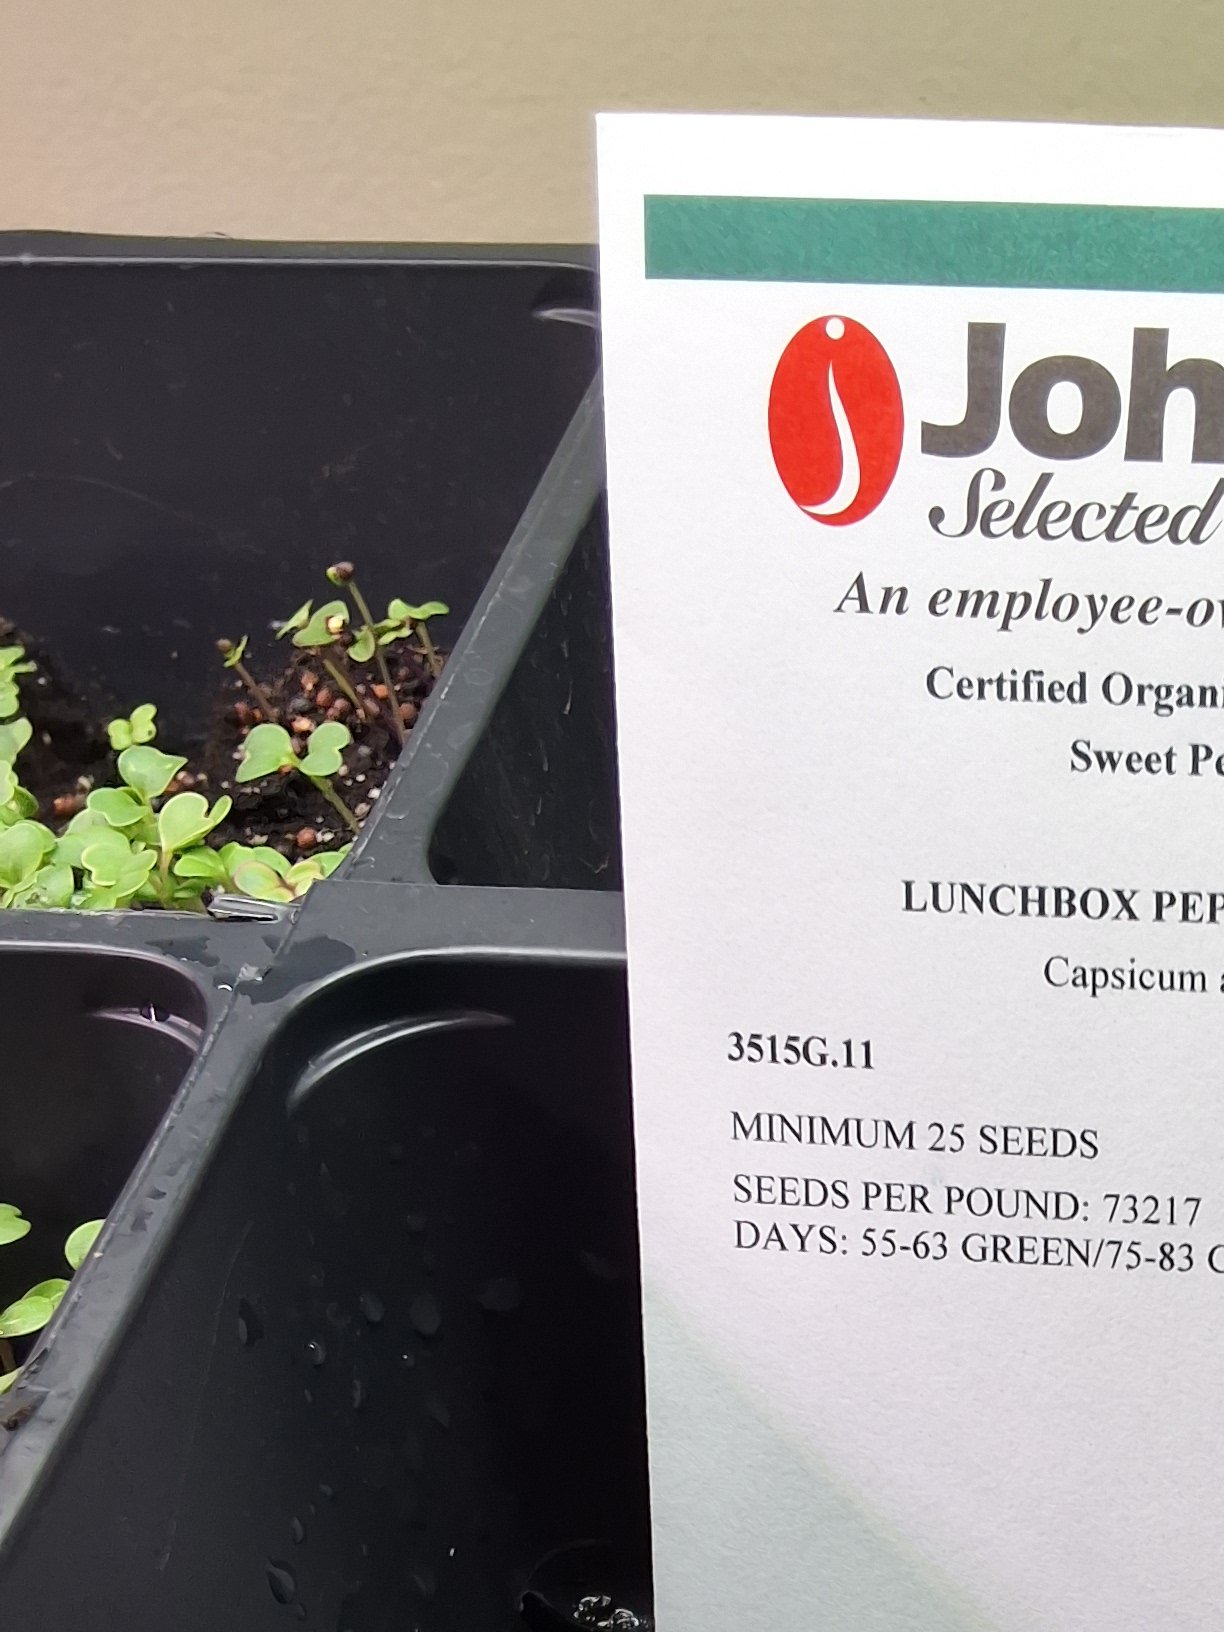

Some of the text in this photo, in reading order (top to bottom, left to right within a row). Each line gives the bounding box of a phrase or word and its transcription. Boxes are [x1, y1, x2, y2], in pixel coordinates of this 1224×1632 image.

[833, 571, 908, 615] An
[927, 666, 1087, 704] Certified
[1071, 740, 1176, 775] Sweet
[903, 881, 1139, 921] LUNCHBOX
[1044, 956, 1206, 998] Capsicum
[728, 1032, 873, 1069] 3515G.11
[732, 1112, 1098, 1159] MINIMUM 25 SEEDS
[734, 1174, 1201, 1226] SEEDS PER POUND: 73217
[735, 1220, 847, 1255] DAYS:
[862, 1228, 947, 1260] 55-63
[962, 1233, 1193, 1272] GREEN/75-83
